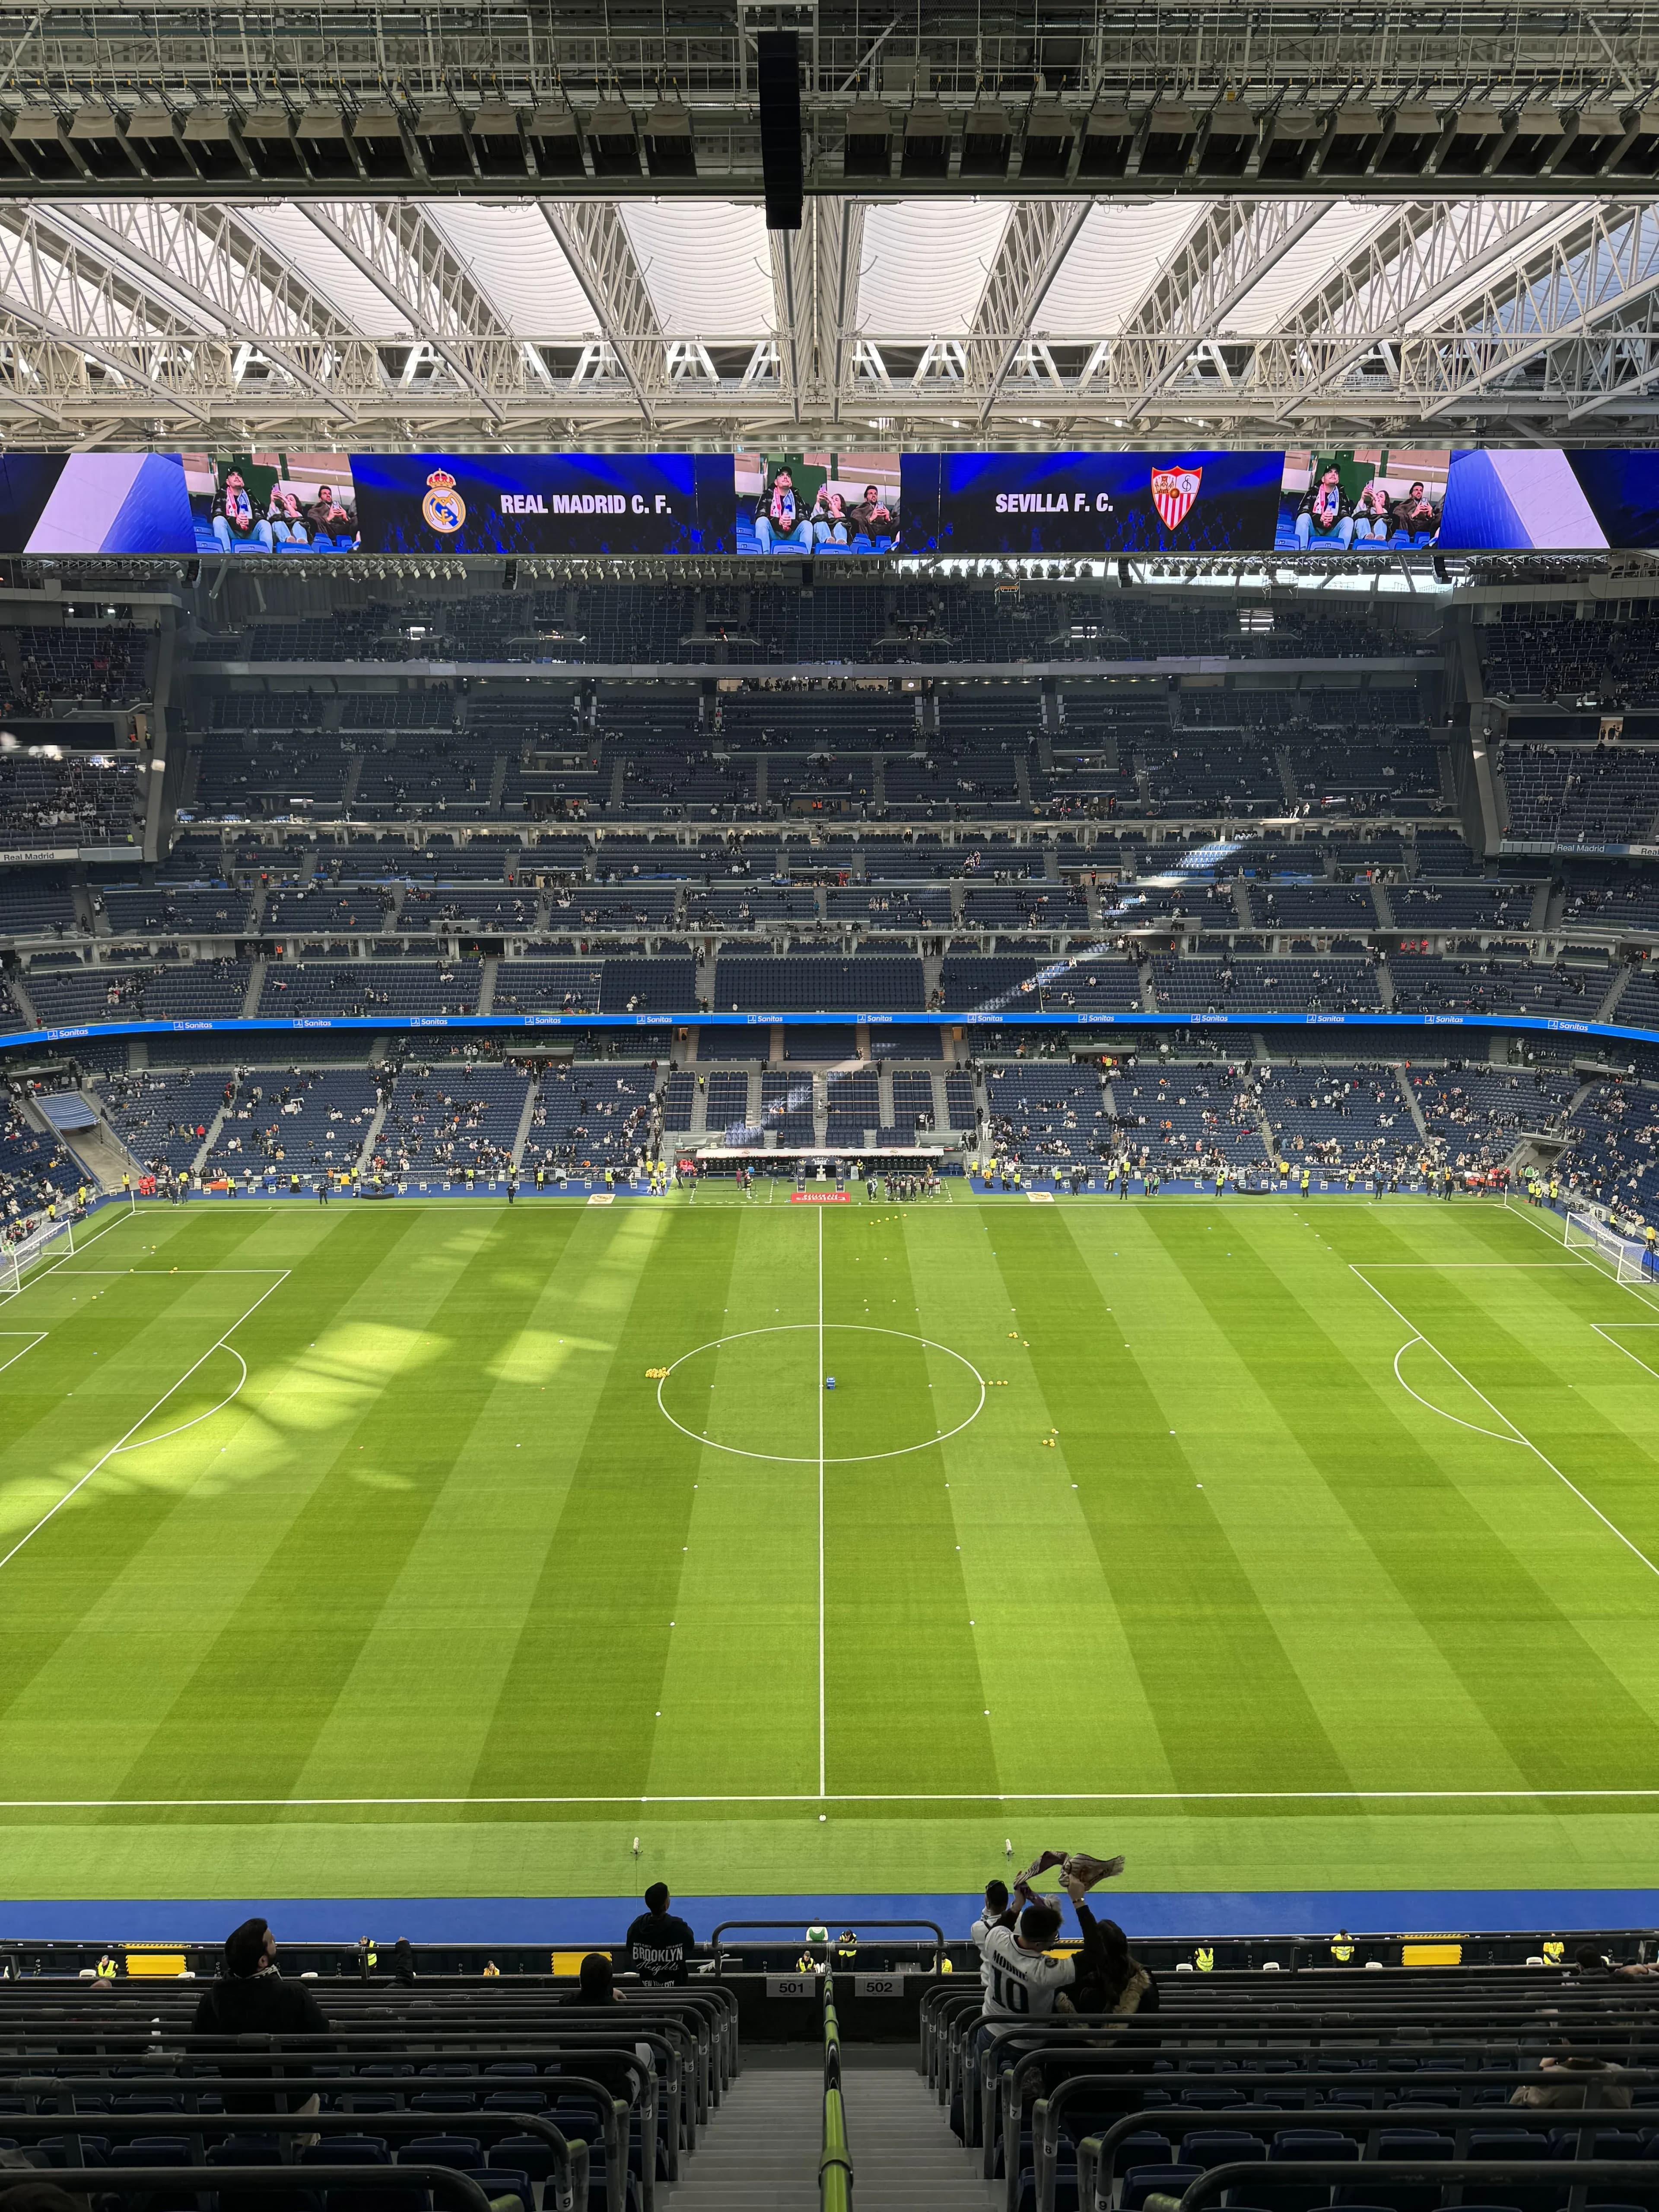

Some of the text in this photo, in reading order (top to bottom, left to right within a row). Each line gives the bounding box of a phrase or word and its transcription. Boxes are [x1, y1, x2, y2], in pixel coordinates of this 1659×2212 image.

[500, 494, 671, 514] REAL MADRID C. F.
[995, 493, 1113, 513] SEVILLA F. C.
[1559, 1022, 1588, 1031] Sanitas
[59, 1029, 88, 1037] Sanitas
[633, 1946, 683, 1962] BROOKLYN
[636, 1960, 680, 1976] Heights
[779, 1983, 803, 1993] 501
[866, 1982, 893, 1993] 502
[992, 1964, 1030, 2013] 10
[645, 2109, 651, 2117] 7
[1046, 2145, 1052, 2154] 8
[563, 2197, 571, 2208] 9
[1099, 2200, 1107, 2211] 9
